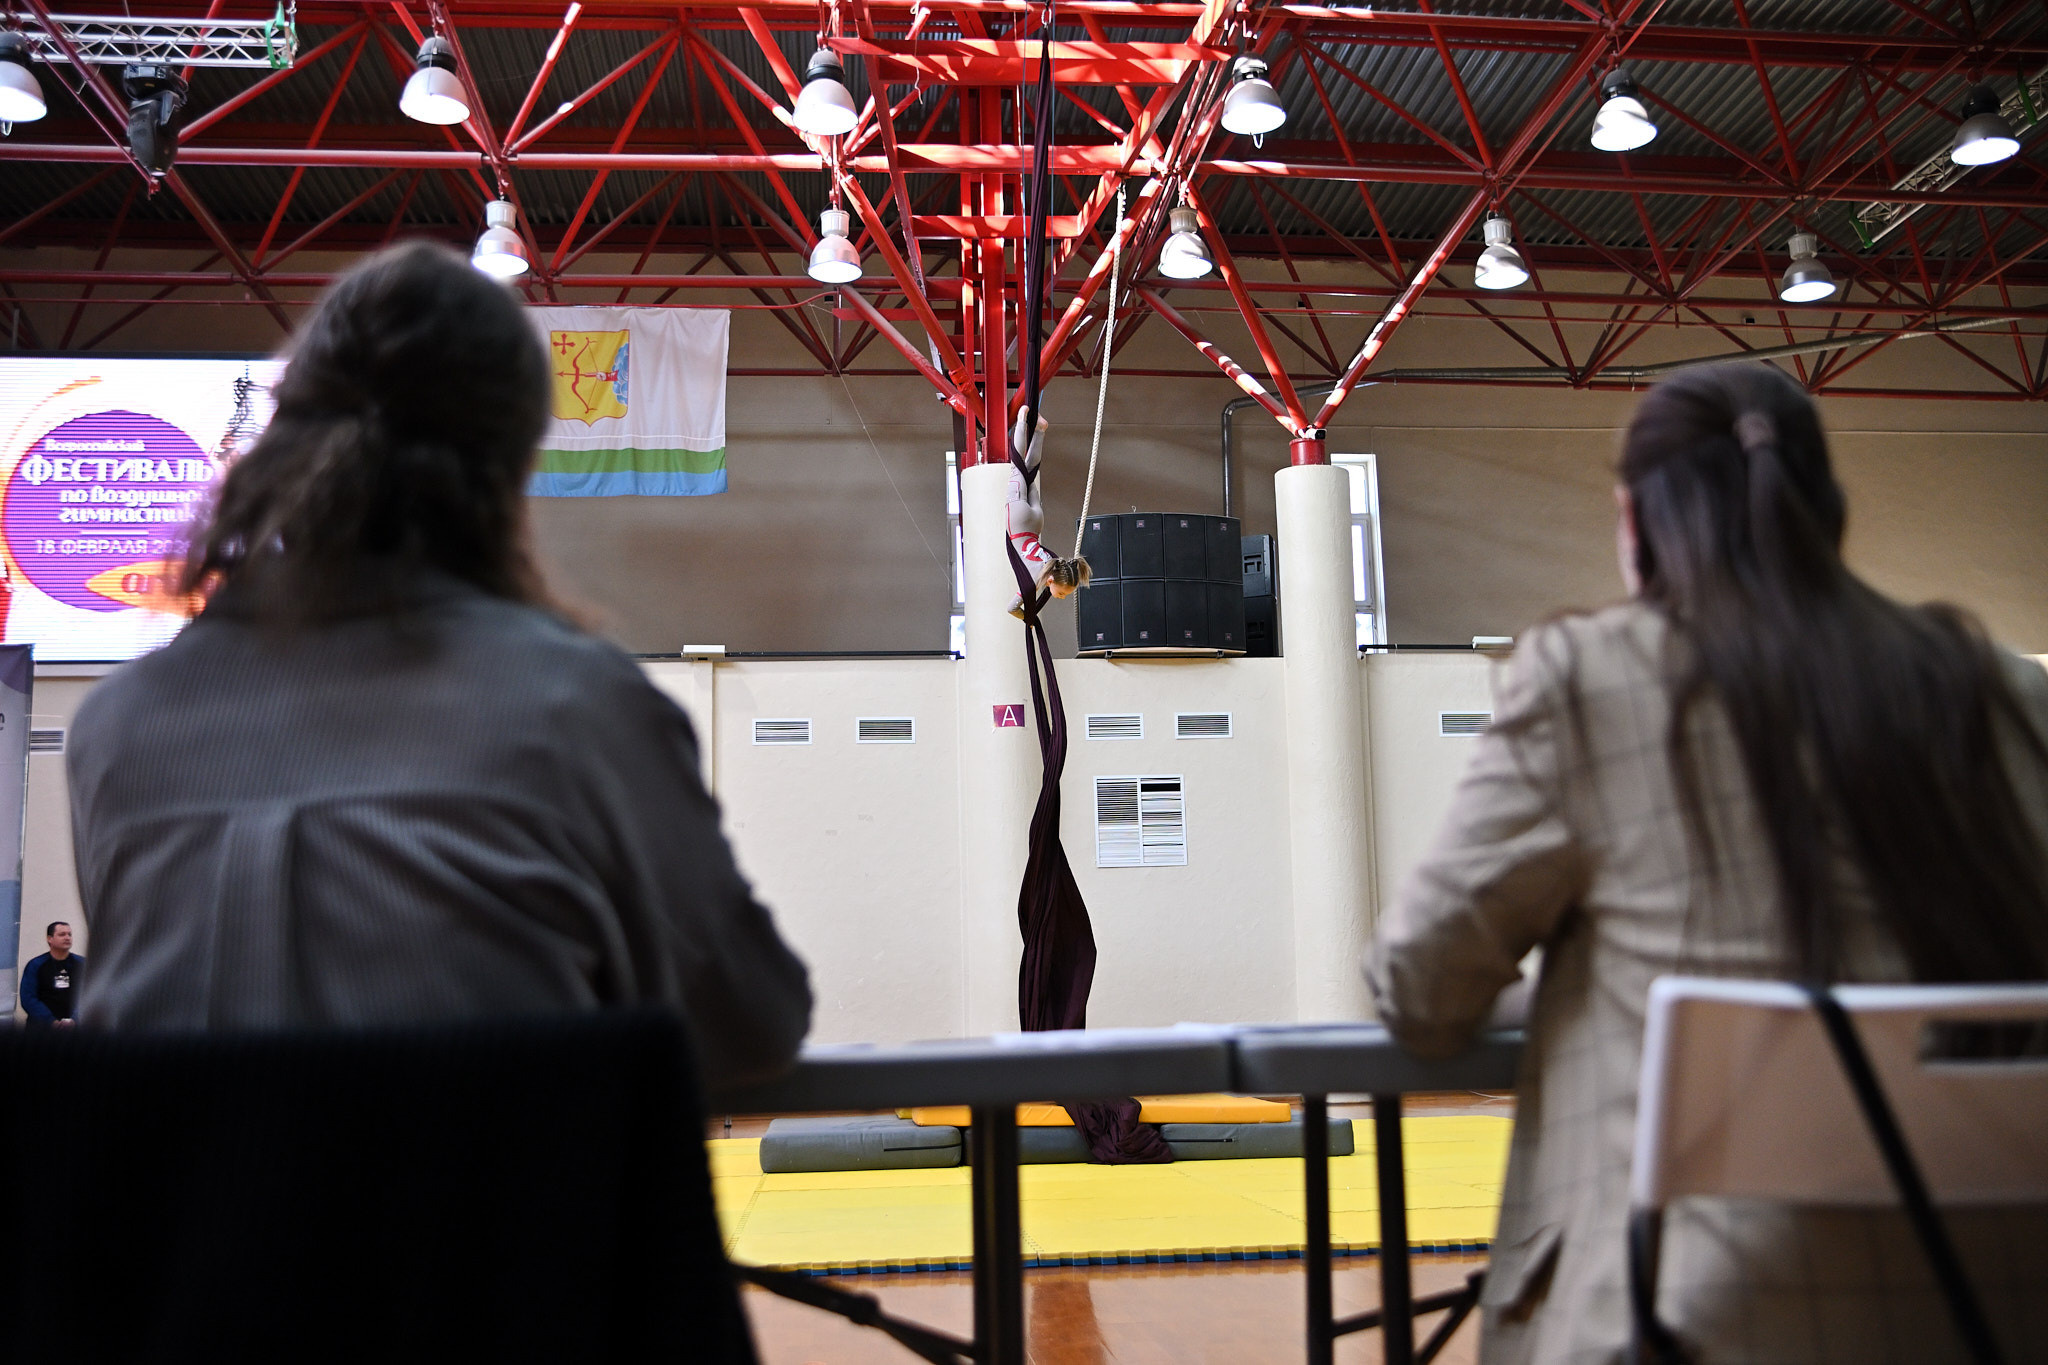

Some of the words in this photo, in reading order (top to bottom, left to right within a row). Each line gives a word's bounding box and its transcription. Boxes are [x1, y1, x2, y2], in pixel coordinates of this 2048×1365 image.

[20, 455, 214, 485] ФЕСТИВАЛЬ
[60, 489, 88, 503] по
[60, 539, 148, 555] ФЕВРАЛЯ
